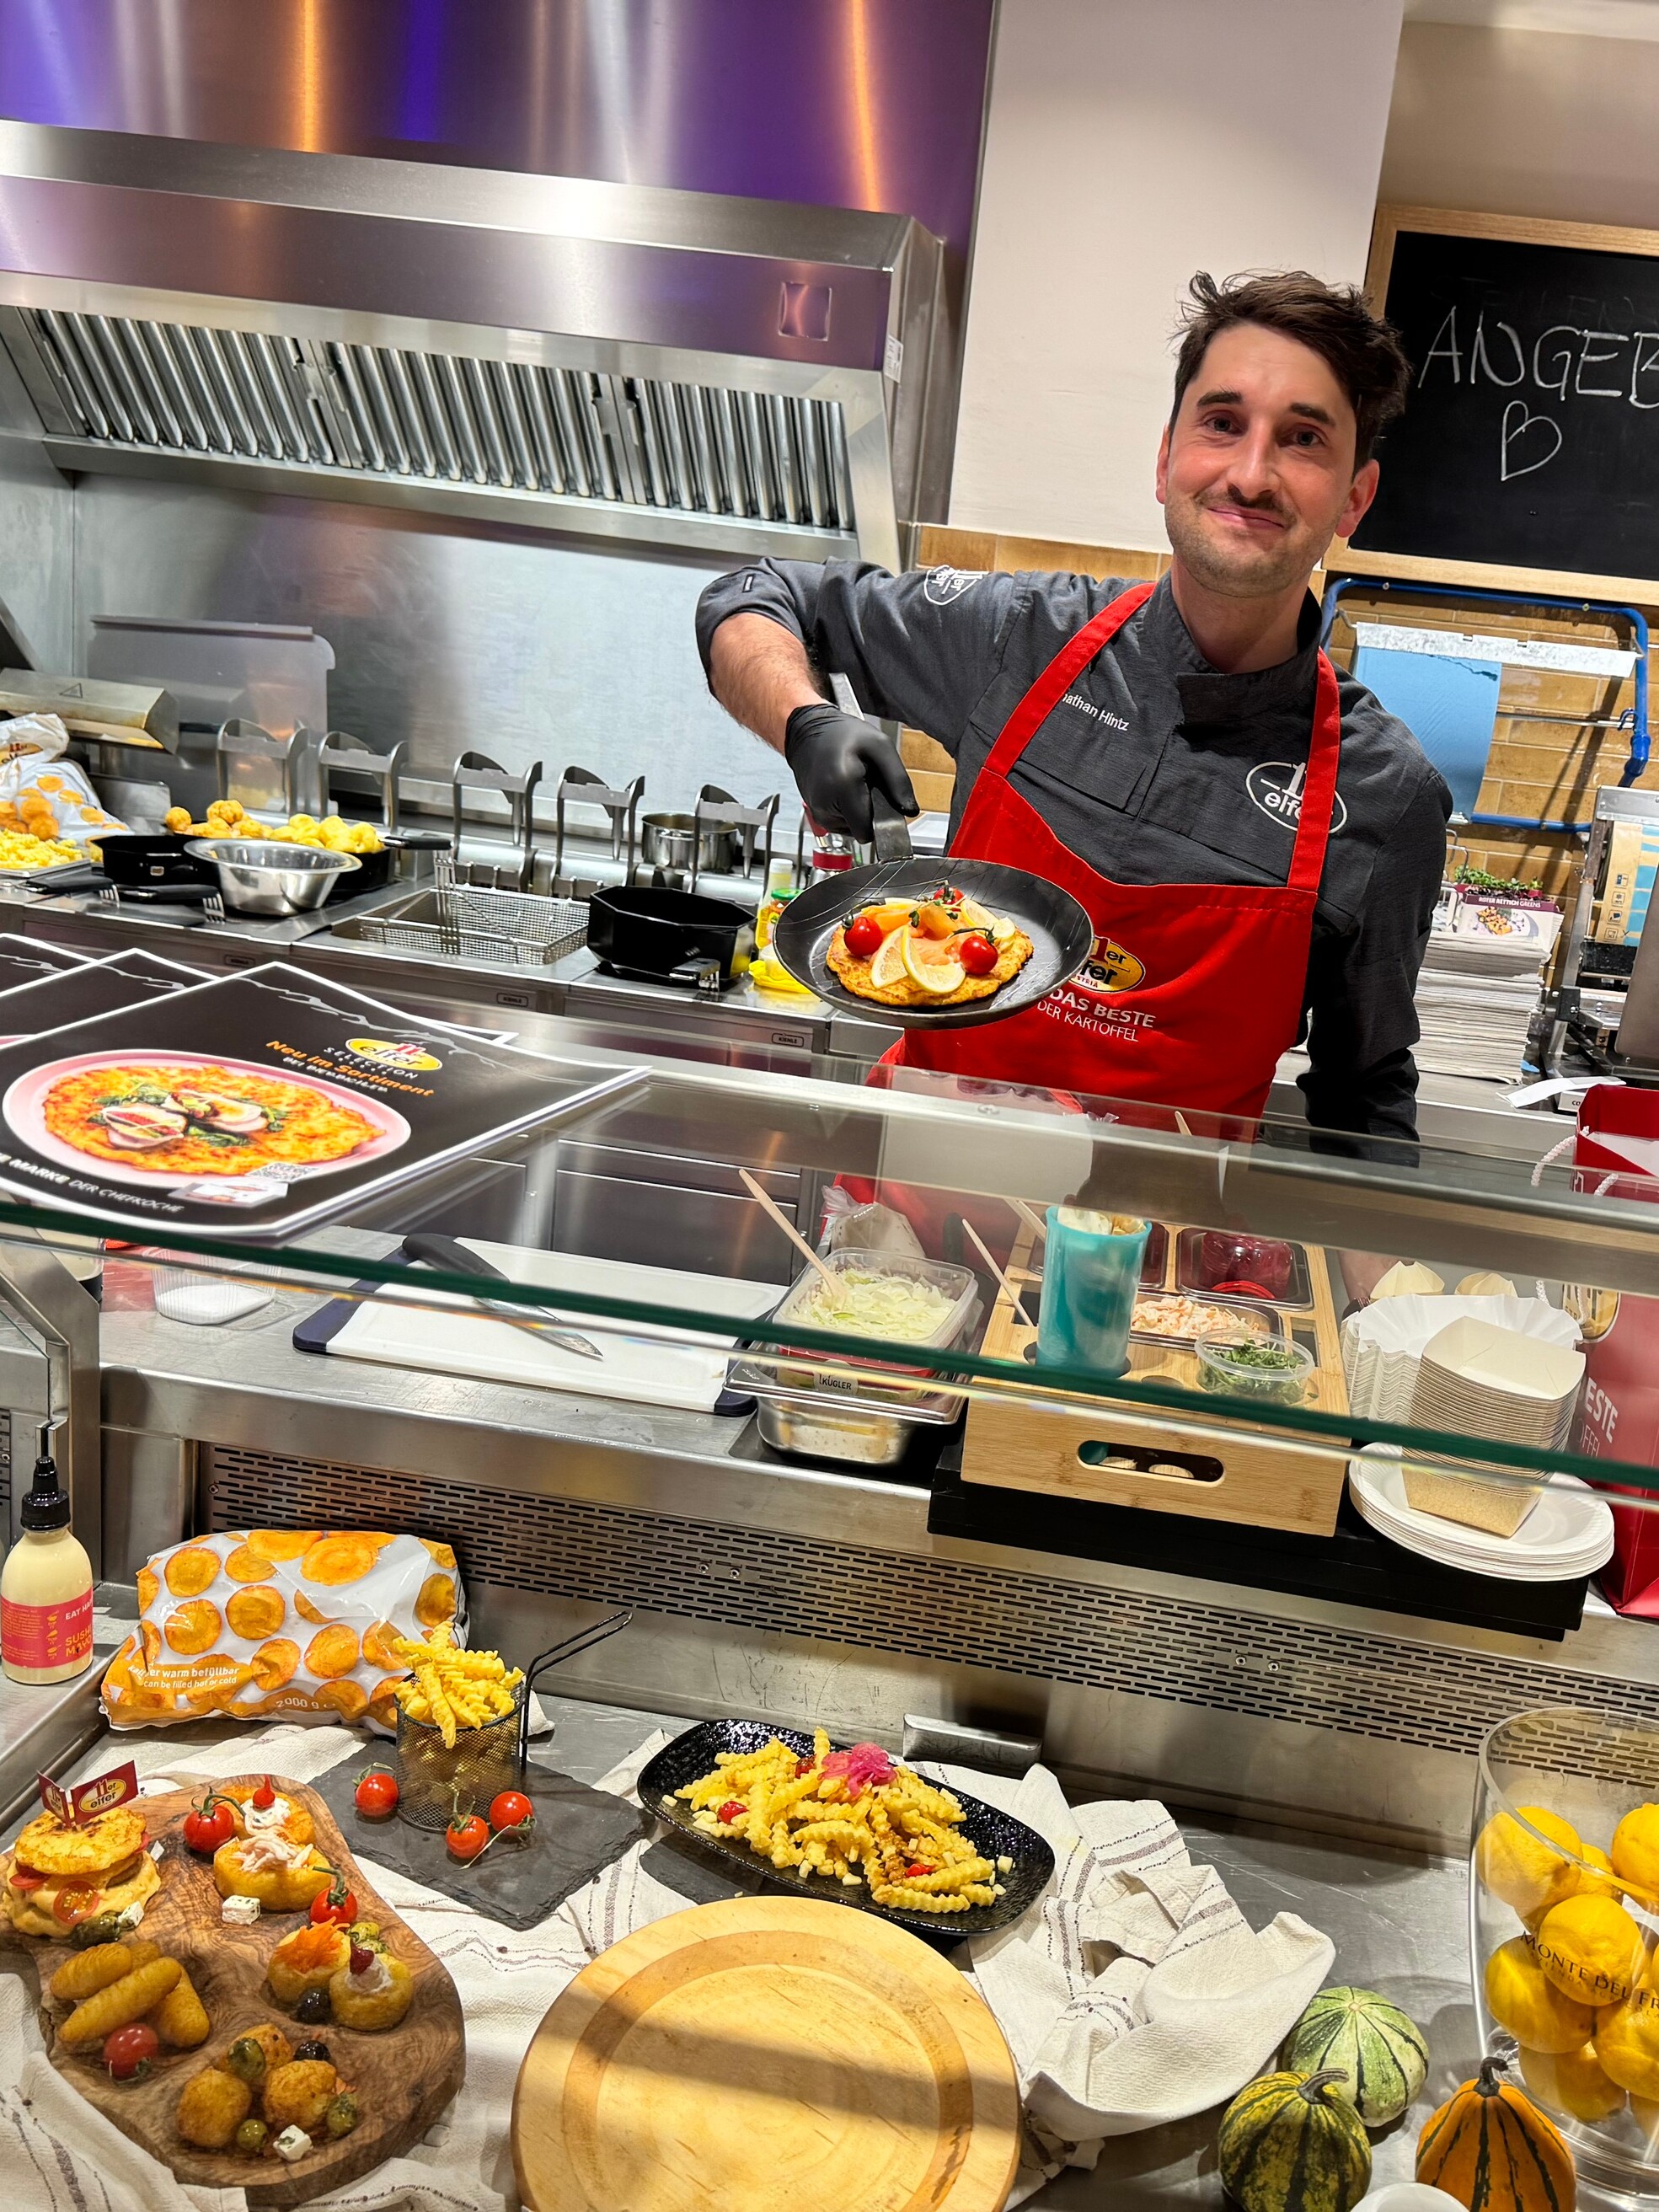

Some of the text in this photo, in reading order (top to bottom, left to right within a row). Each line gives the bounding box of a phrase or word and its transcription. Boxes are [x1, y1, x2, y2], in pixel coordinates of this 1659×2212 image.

[1098, 710, 1130, 731] Hintz
[1050, 988, 1156, 1028] DAS BESTE
[1037, 1000, 1139, 1042] DER KARTOFFEL
[324, 1047, 420, 1079] SELECTION
[359, 1046, 423, 1066] elfer
[265, 1040, 308, 1059] Neu
[306, 1055, 334, 1069] im
[334, 1064, 436, 1097] Sortiment
[8, 1158, 71, 1185] MARKE
[68, 1179, 99, 1194] DER
[65, 1608, 82, 1620] EAT
[143, 1679, 159, 1688] can
[160, 1679, 171, 1689] be
[172, 1679, 193, 1689] filled
[193, 1679, 209, 1689] hot
[218, 1676, 238, 1684] cold
[162, 1670, 190, 1679] warm
[191, 1668, 240, 1679] befüllbar
[276, 1697, 308, 1708] 2000
[94, 1778, 116, 1798] 11er
[90, 1792, 116, 1808] elfer
[1520, 1931, 1588, 1980] MONTE
[1595, 1974, 1631, 2000] DEL
